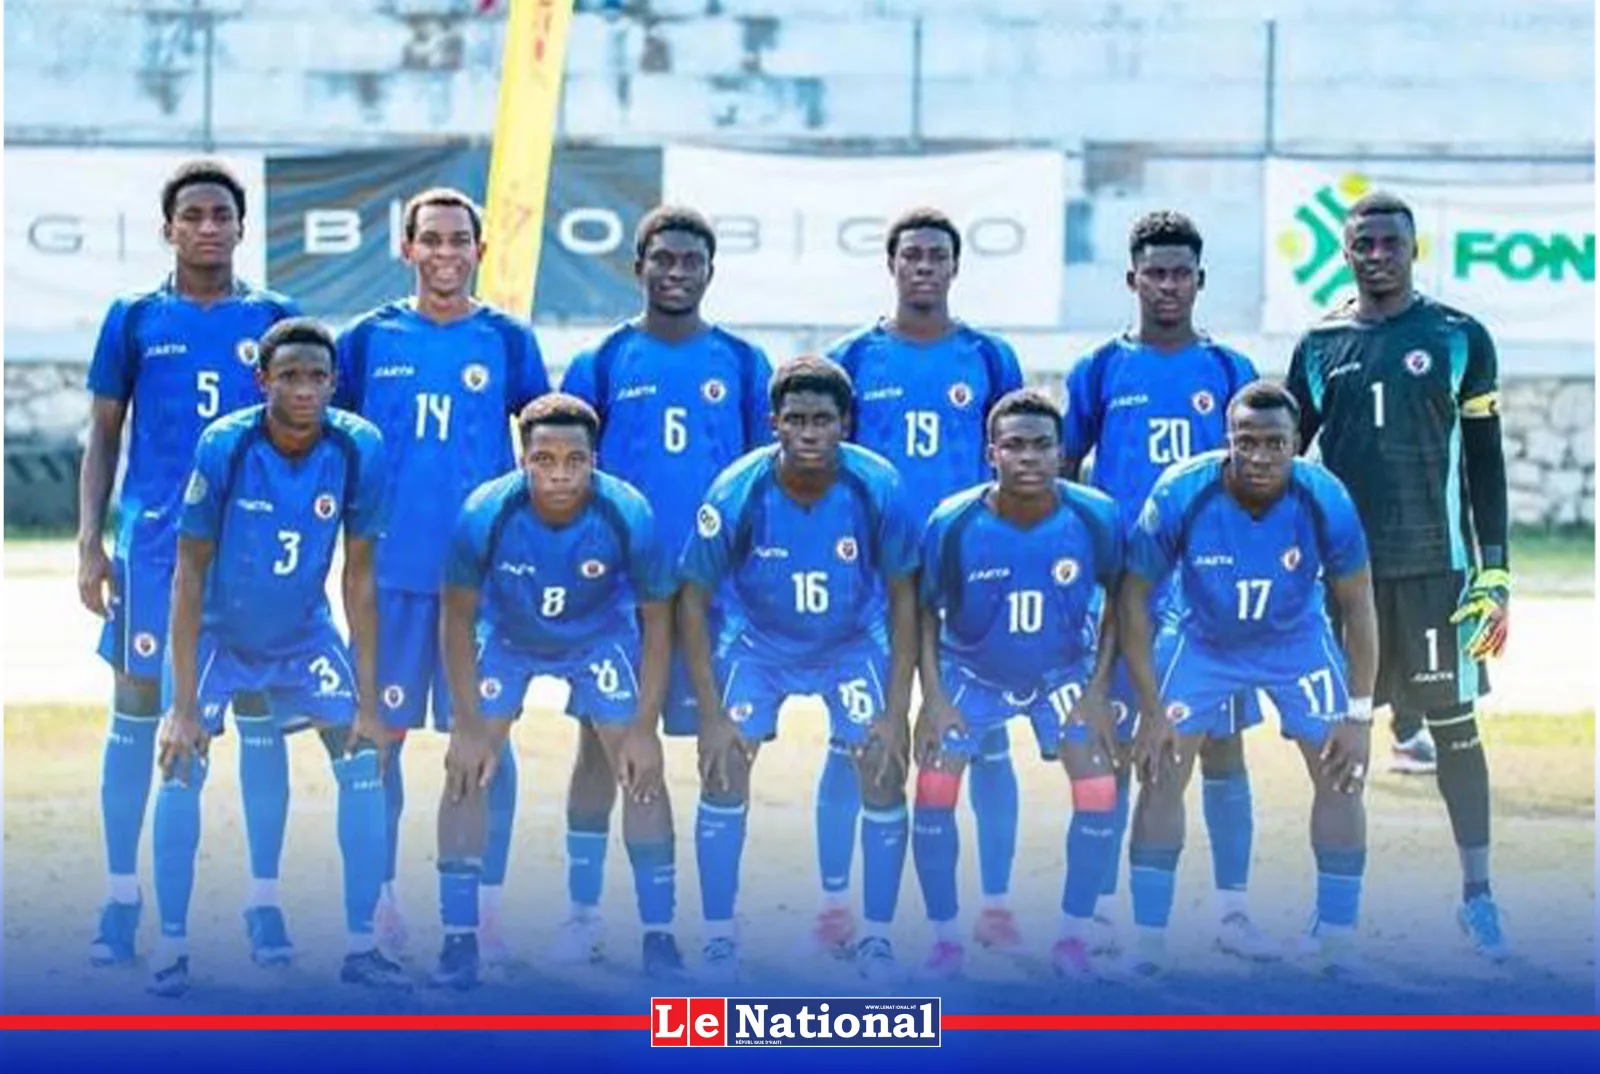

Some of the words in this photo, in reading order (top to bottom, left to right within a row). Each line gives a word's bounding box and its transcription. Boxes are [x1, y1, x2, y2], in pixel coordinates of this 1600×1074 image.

[1455, 231, 1596, 281] FON
[197, 371, 220, 418] 5
[416, 393, 452, 441] 14
[1371, 382, 1385, 427] 1
[664, 407, 687, 454] 6
[905, 411, 939, 457] 19
[1150, 418, 1191, 463] 20
[273, 530, 301, 575] 3
[542, 586, 566, 617] 8
[792, 571, 828, 613] 16
[1008, 590, 1043, 633] 10
[1236, 579, 1272, 620] 17
[1425, 628, 1438, 671] 1
[309, 656, 340, 695] 3
[1299, 669, 1335, 715] 17
